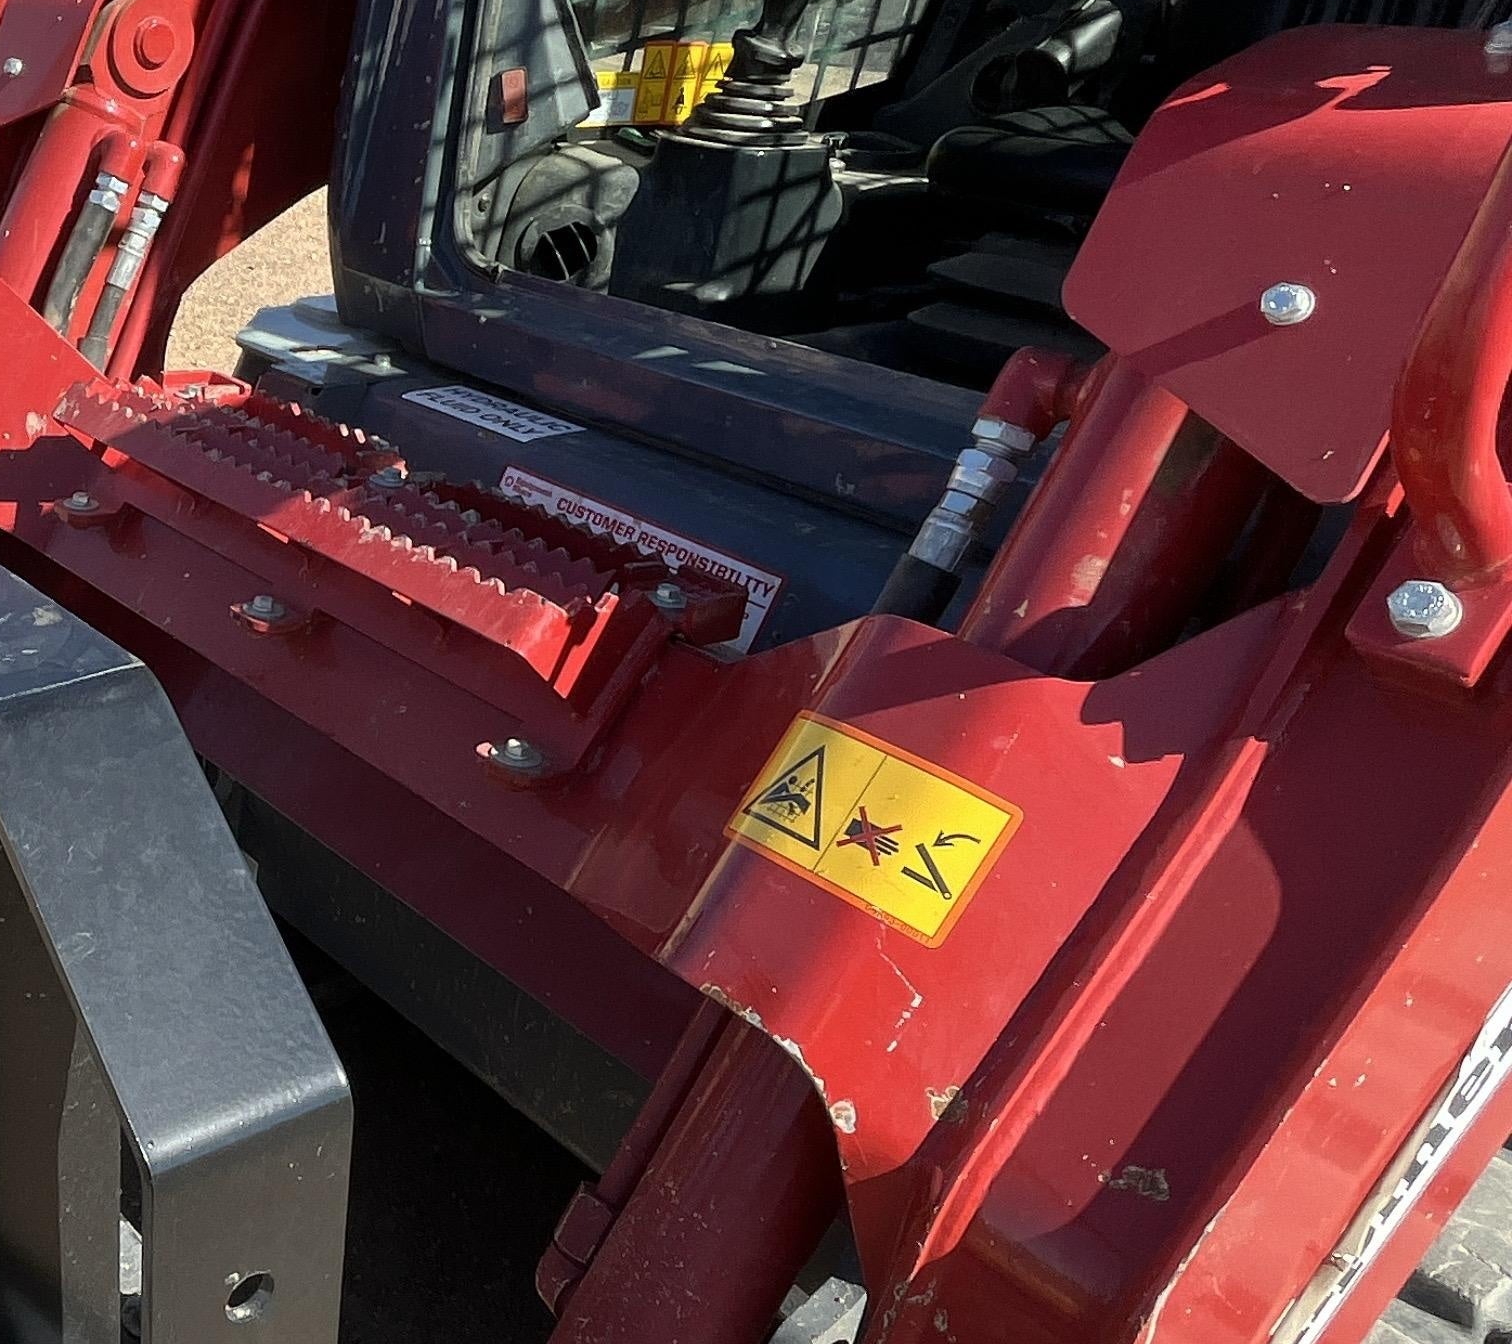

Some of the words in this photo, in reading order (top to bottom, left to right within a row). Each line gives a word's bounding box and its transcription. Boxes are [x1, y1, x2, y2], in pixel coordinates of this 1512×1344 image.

[416, 389, 479, 418] FLUID
[478, 410, 541, 436] ONLY
[446, 387, 575, 433] HYDRAULIC
[556, 496, 637, 540] CUSTOMER
[637, 530, 775, 598] RESPONSIBILITY
